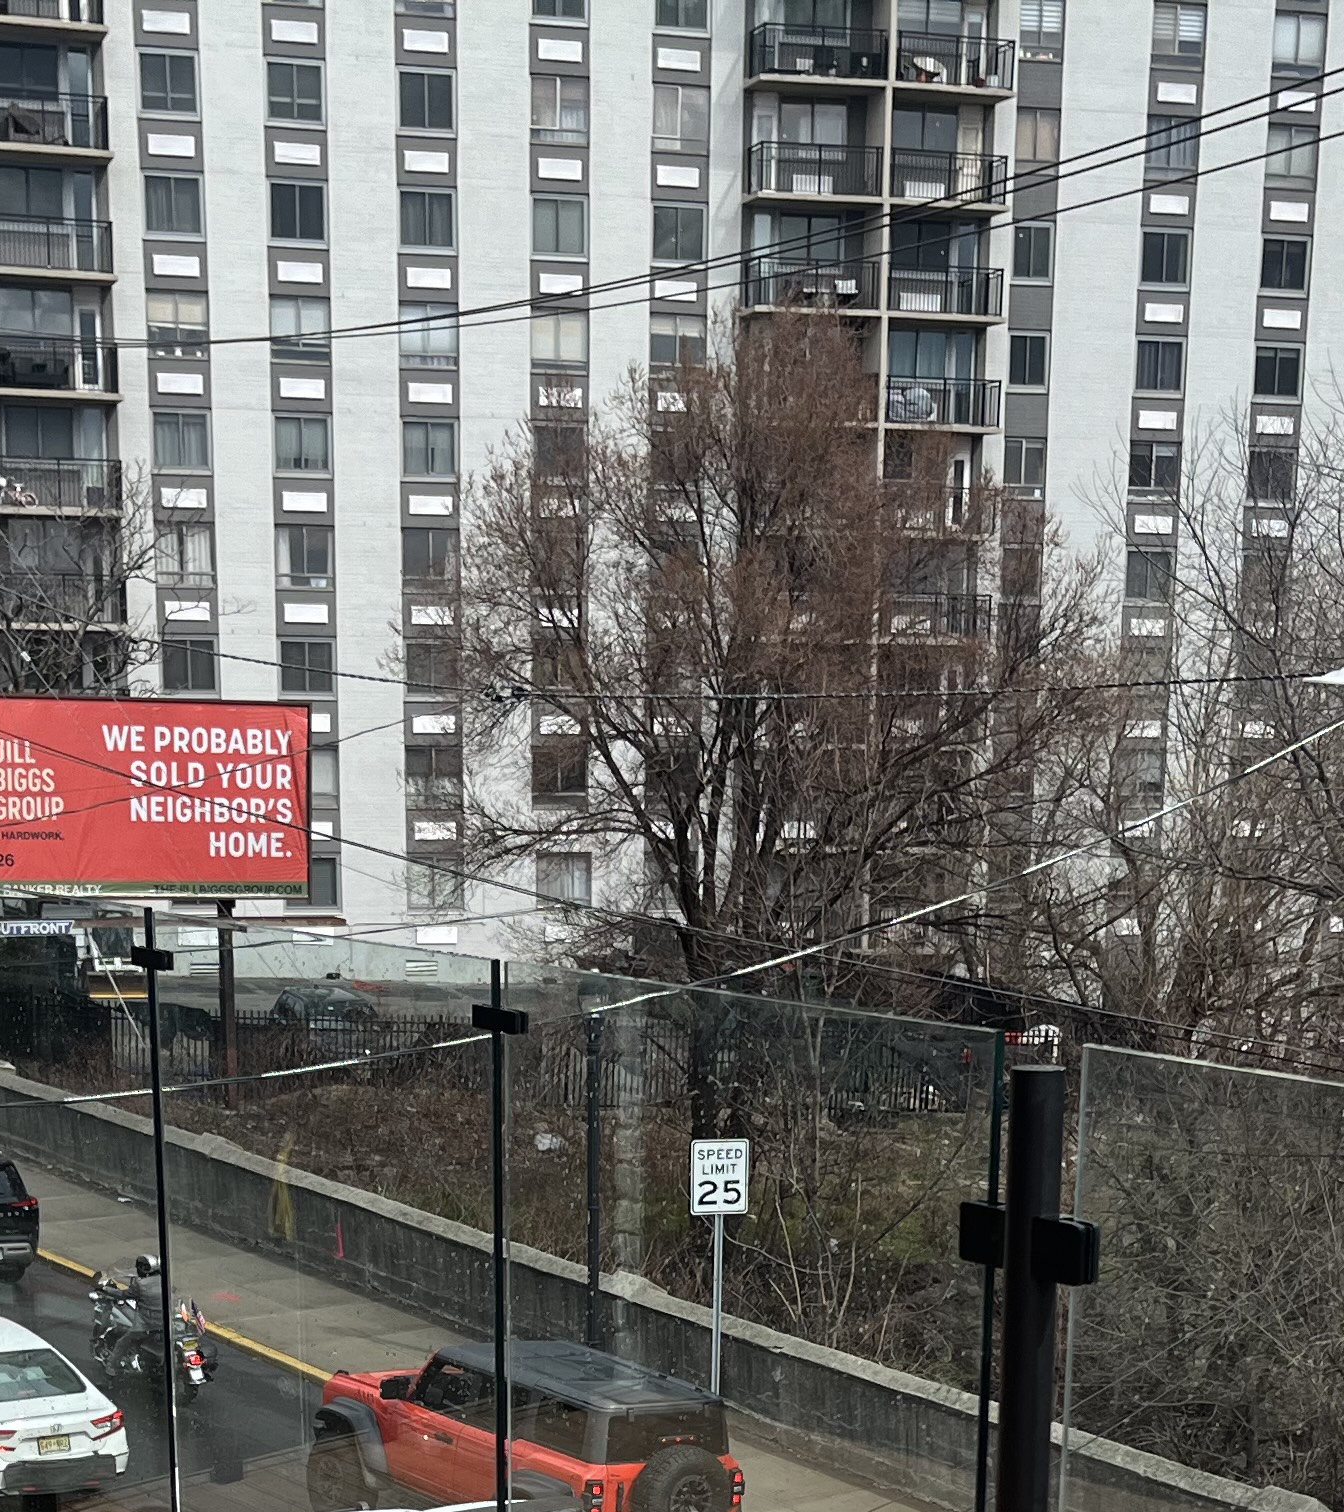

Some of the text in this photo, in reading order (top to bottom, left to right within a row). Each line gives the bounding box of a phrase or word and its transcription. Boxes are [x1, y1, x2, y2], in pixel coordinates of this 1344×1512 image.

[102, 724, 292, 755] WE PROBABLY
[130, 760, 292, 790] SOLD YOUR
[130, 795, 293, 824] NEIGHBOR'S
[2, 831, 64, 841] HARDWORK.
[209, 832, 293, 857] HOME.
[56, 884, 102, 896] REALTY
[697, 1148, 743, 1160] SPEED
[702, 1163, 737, 1175] LIMIT
[697, 1180, 741, 1206] 25
